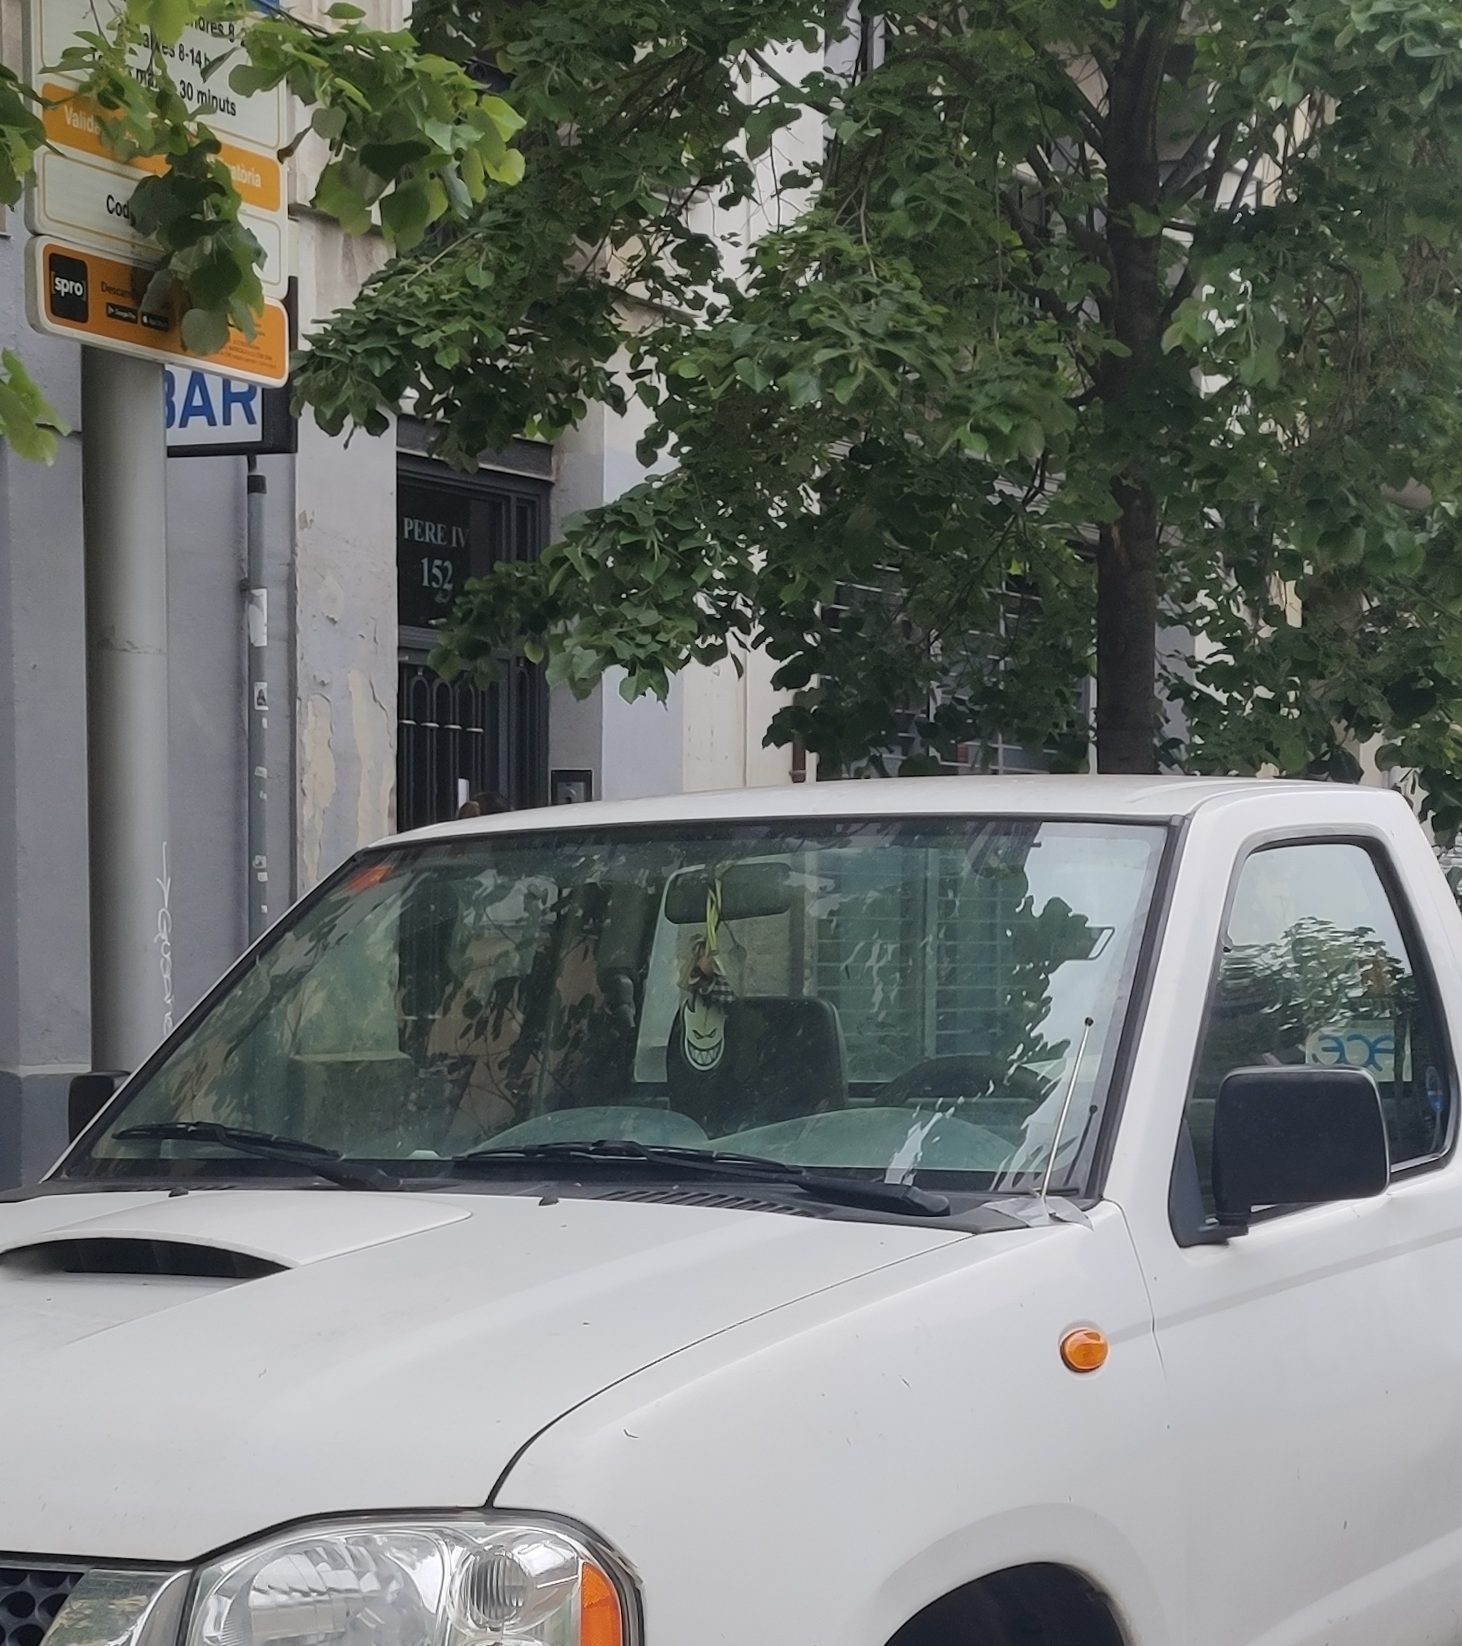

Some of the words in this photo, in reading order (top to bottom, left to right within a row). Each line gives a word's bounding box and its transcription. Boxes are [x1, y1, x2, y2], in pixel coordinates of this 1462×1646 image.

[180, 80, 193, 101] 30
[196, 90, 237, 117] minuts
[65, 104, 101, 135] Valida
[231, 164, 262, 188] atòria
[106, 195, 130, 219] Cod
[54, 277, 83, 297] spro
[403, 516, 448, 545] PERE
[451, 525, 469, 549] IV
[421, 557, 453, 590] 152
